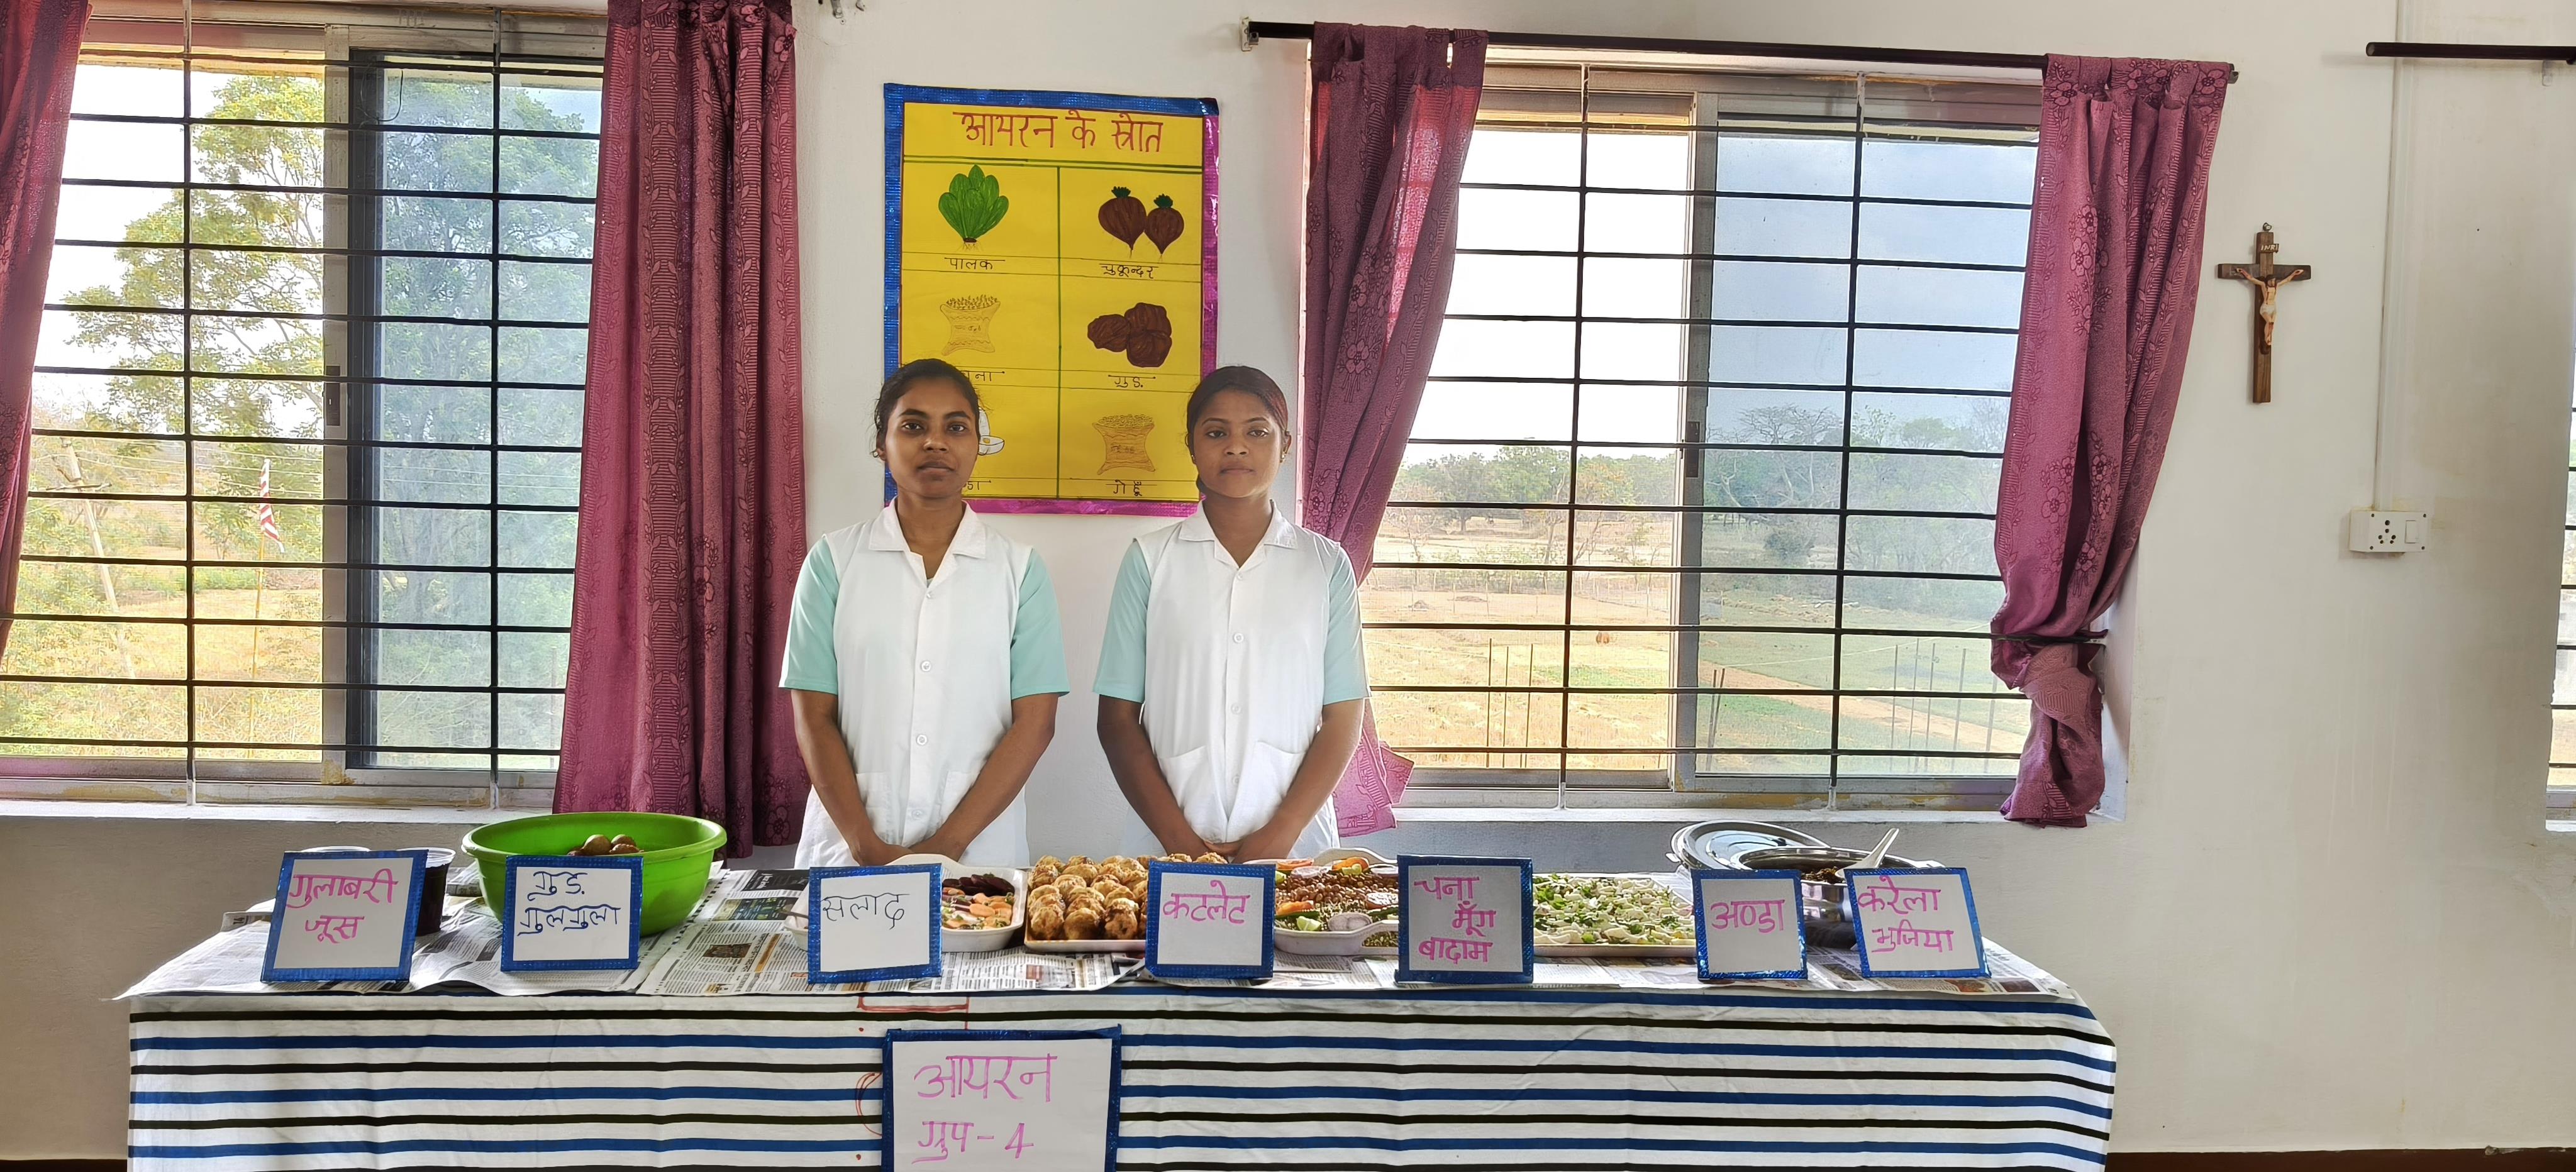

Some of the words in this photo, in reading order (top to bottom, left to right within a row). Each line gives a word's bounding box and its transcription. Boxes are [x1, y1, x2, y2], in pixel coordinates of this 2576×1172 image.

[952, 111, 1058, 148] आयरन
[1065, 109, 1096, 149] के
[944, 257, 1006, 270] पालक
[960, 370, 1005, 382] ना
[286, 868, 399, 909] गुलाबरी
[1163, 879, 1250, 924] कटलेट
[1414, 876, 1479, 901] चना
[1858, 875, 1941, 915] करेला
[517, 903, 621, 936] गुलगुला
[820, 892, 910, 929] सलाद
[1452, 900, 1497, 937] मूँग
[1710, 899, 1785, 934] अण्डा
[304, 914, 365, 944] जूस
[1871, 919, 1955, 953] भुजिया
[1418, 936, 1494, 965] बादाम
[913, 1053, 1058, 1103] आयरन
